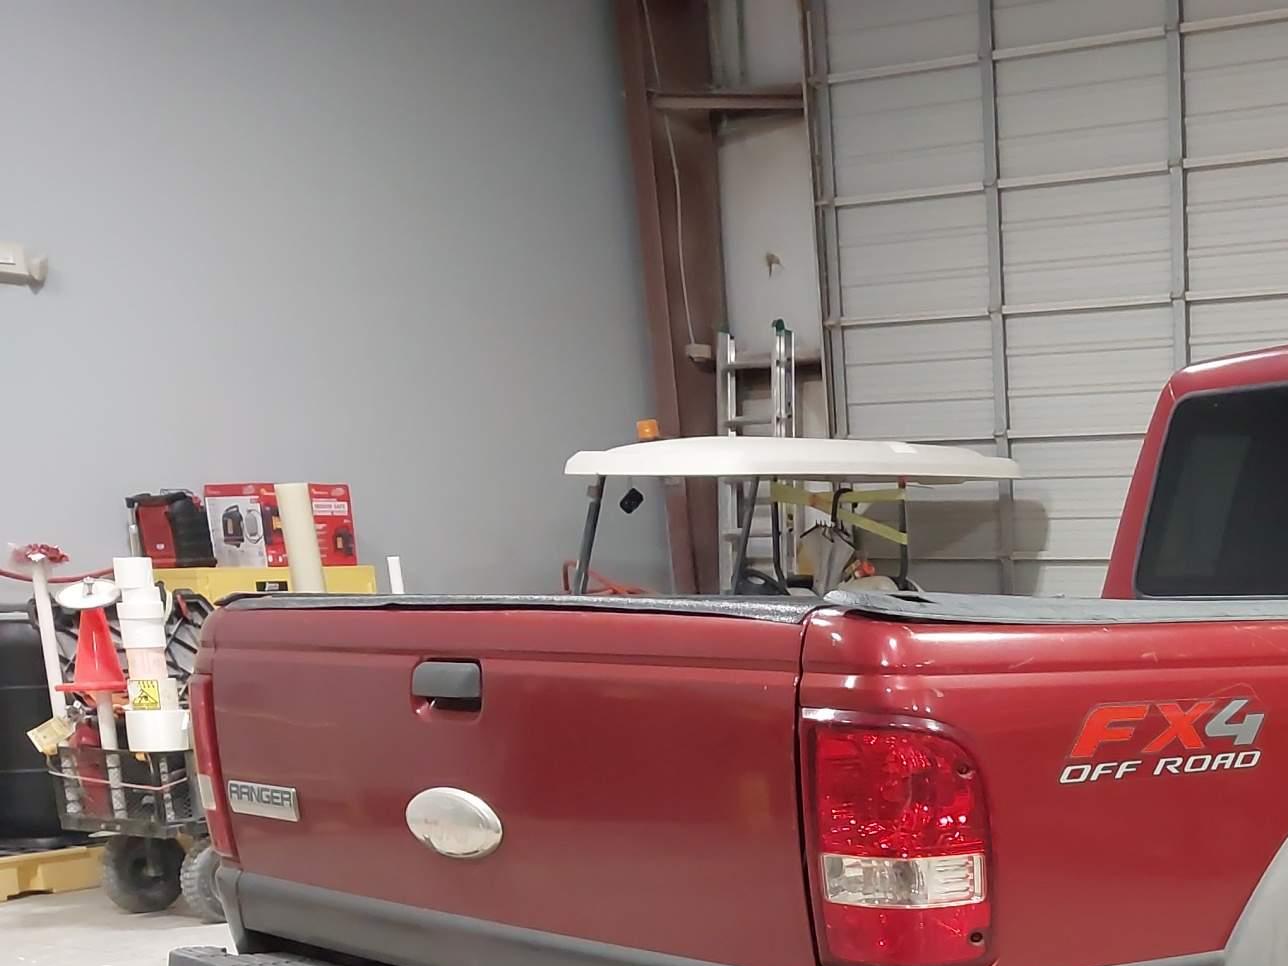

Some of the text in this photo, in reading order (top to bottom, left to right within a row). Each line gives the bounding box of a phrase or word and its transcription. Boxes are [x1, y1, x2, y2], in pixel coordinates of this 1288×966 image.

[1070, 699, 1265, 758] FX4
[1059, 750, 1262, 784] OFF ROAD
[229, 783, 292, 807] RANGER
